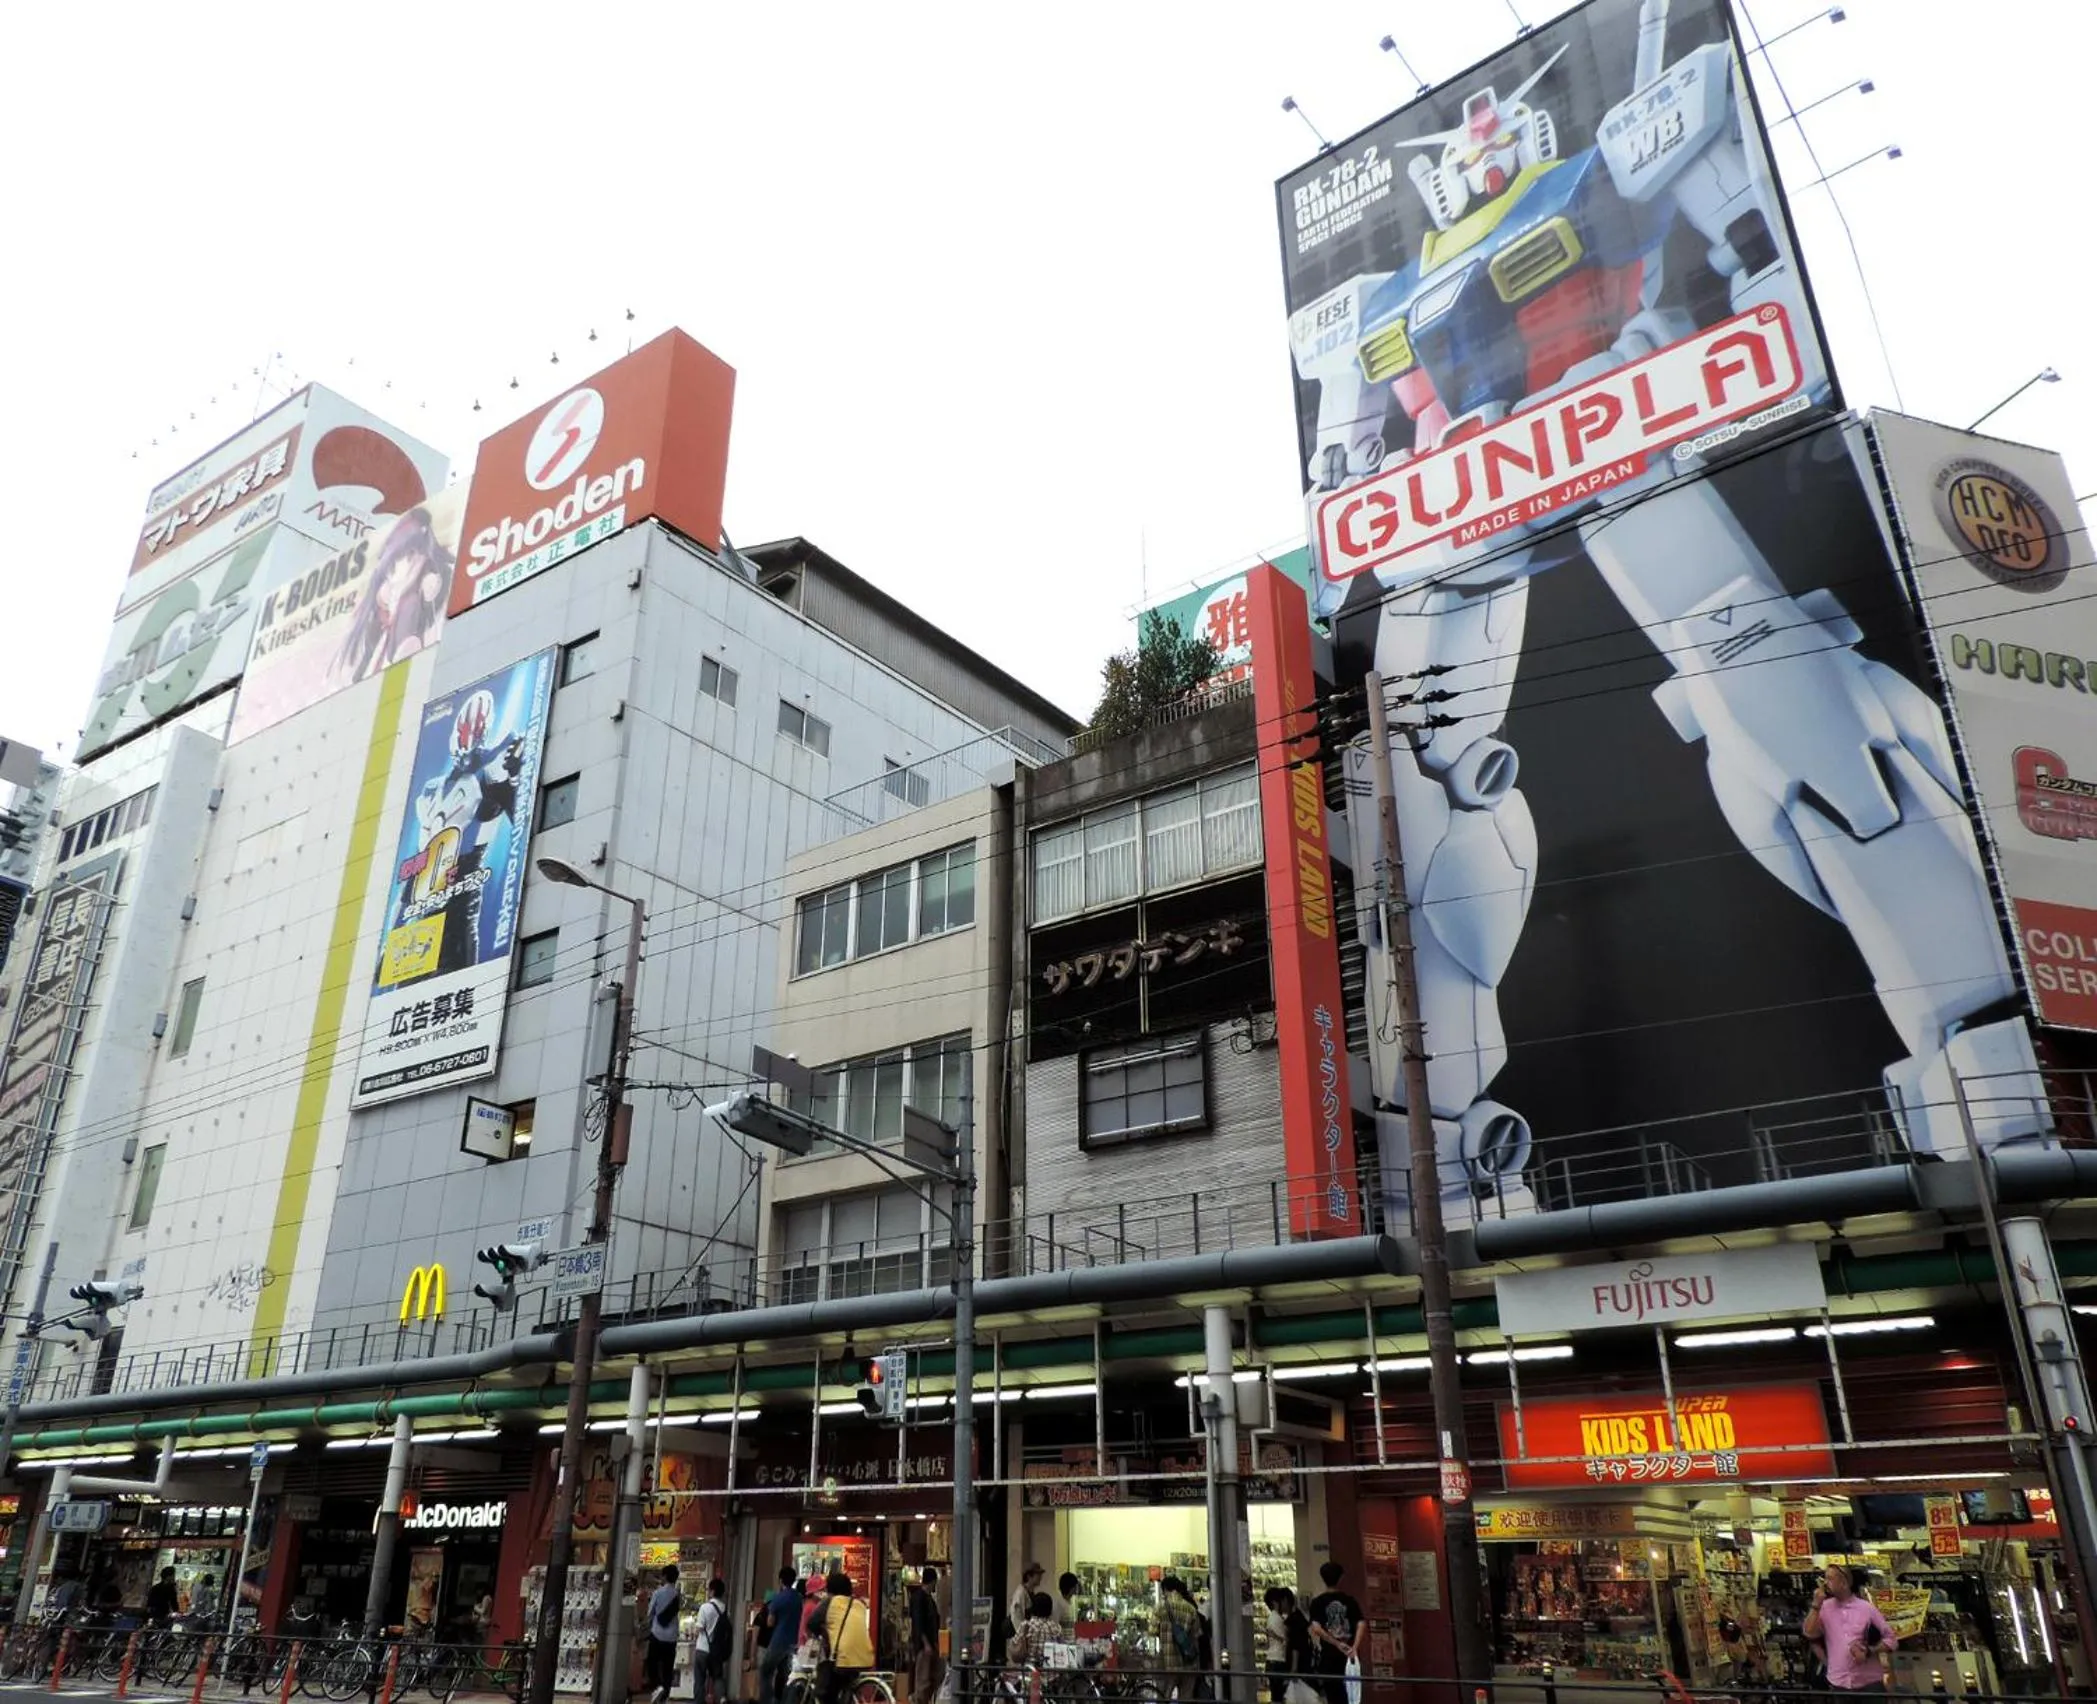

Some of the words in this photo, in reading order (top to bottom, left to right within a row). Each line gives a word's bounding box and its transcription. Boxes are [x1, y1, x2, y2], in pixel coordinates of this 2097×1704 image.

[1293, 145, 1380, 210] RX-78-2
[1296, 159, 1393, 229] GUNDAM
[1330, 184, 1391, 226] FEDERATION
[1331, 210, 1363, 236] FORCE
[1336, 330, 1777, 558] GUNPLA
[466, 457, 645, 577] Shoden
[1461, 510, 1508, 544] MADE
[1528, 495, 1553, 517] IN
[1560, 461, 1636, 503] JAPAN
[1956, 482, 2032, 529] HCM
[259, 540, 369, 631] K-BOOKS
[481, 555, 540, 595] 株式会社
[1291, 753, 1321, 838] KIDS
[1297, 838, 1330, 939] LAND
[2026, 929, 2097, 962] COL
[389, 987, 476, 1038] 広告募集
[1313, 1004, 1348, 1221] キャラクター館
[1592, 1275, 1715, 1321] FUJITSU
[1581, 1415, 1650, 1456] KIDS
[1654, 1412, 1736, 1455] LAND
[1586, 1453, 1740, 1481] キャラクター館
